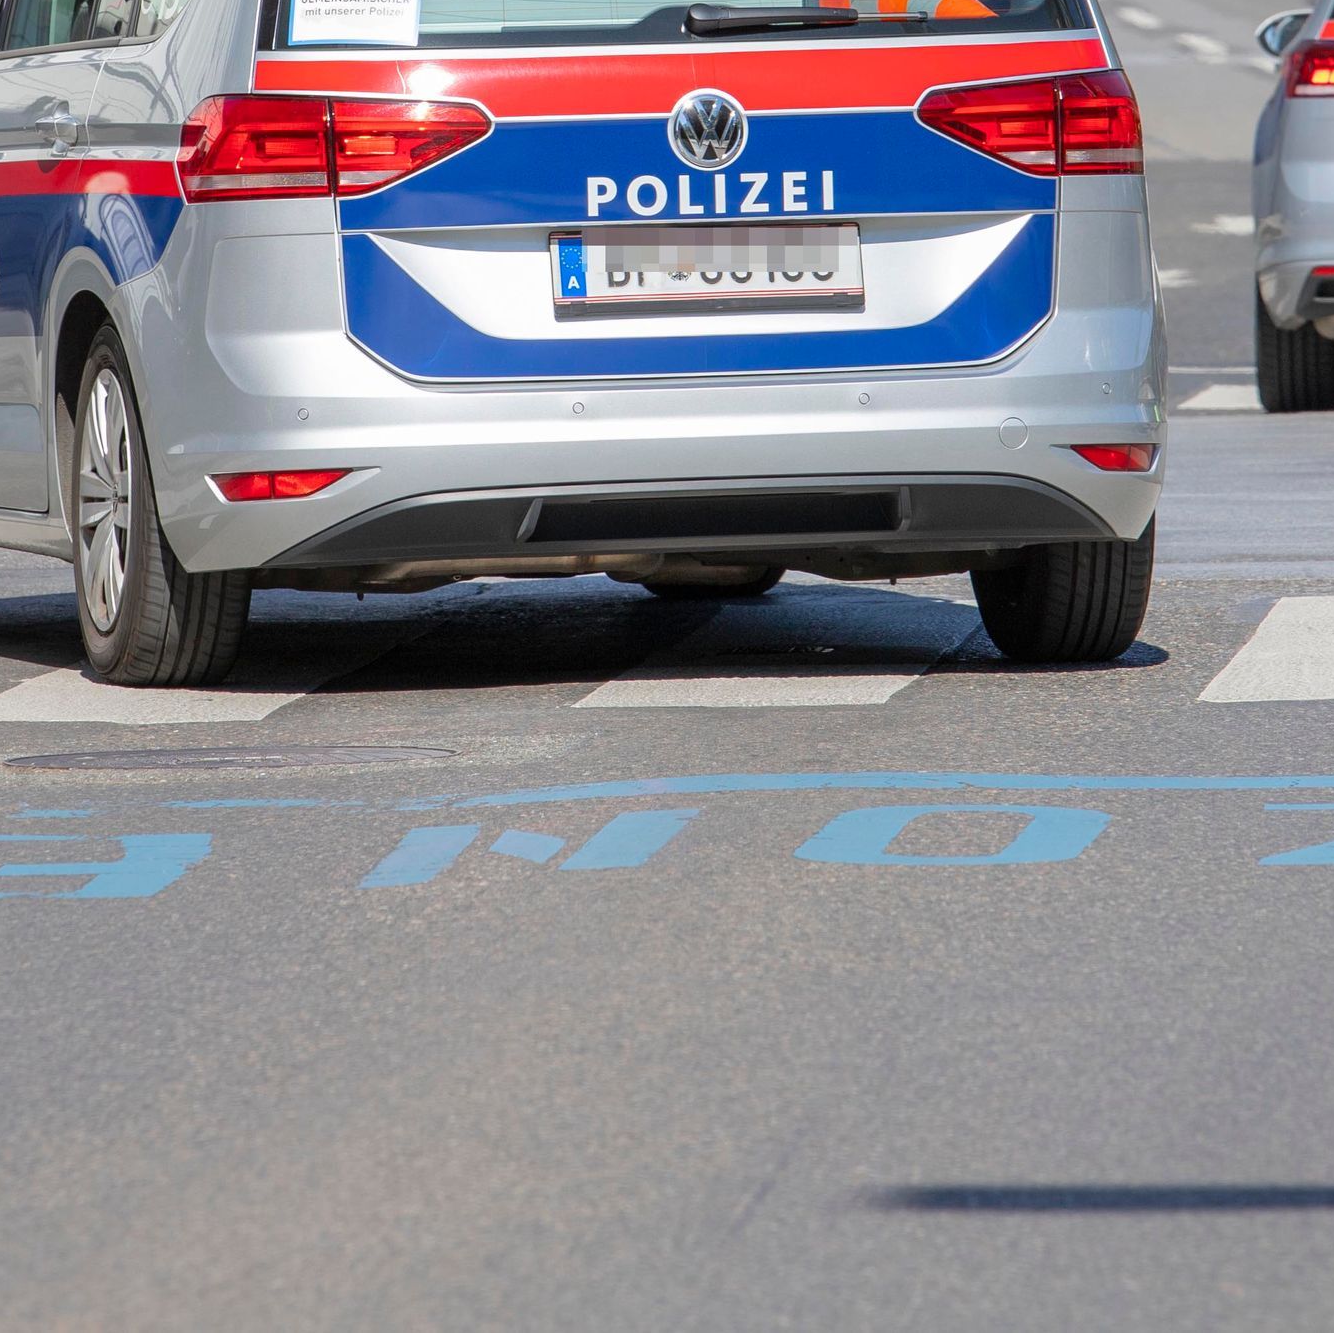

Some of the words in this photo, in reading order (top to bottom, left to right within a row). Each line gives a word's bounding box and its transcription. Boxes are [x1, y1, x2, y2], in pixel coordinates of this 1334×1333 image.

[305, 7, 322, 17] mit
[324, 7, 366, 16] unserer
[369, 6, 405, 17] Polizei
[586, 170, 835, 217] POLIZEI
[567, 275, 580, 290] A
